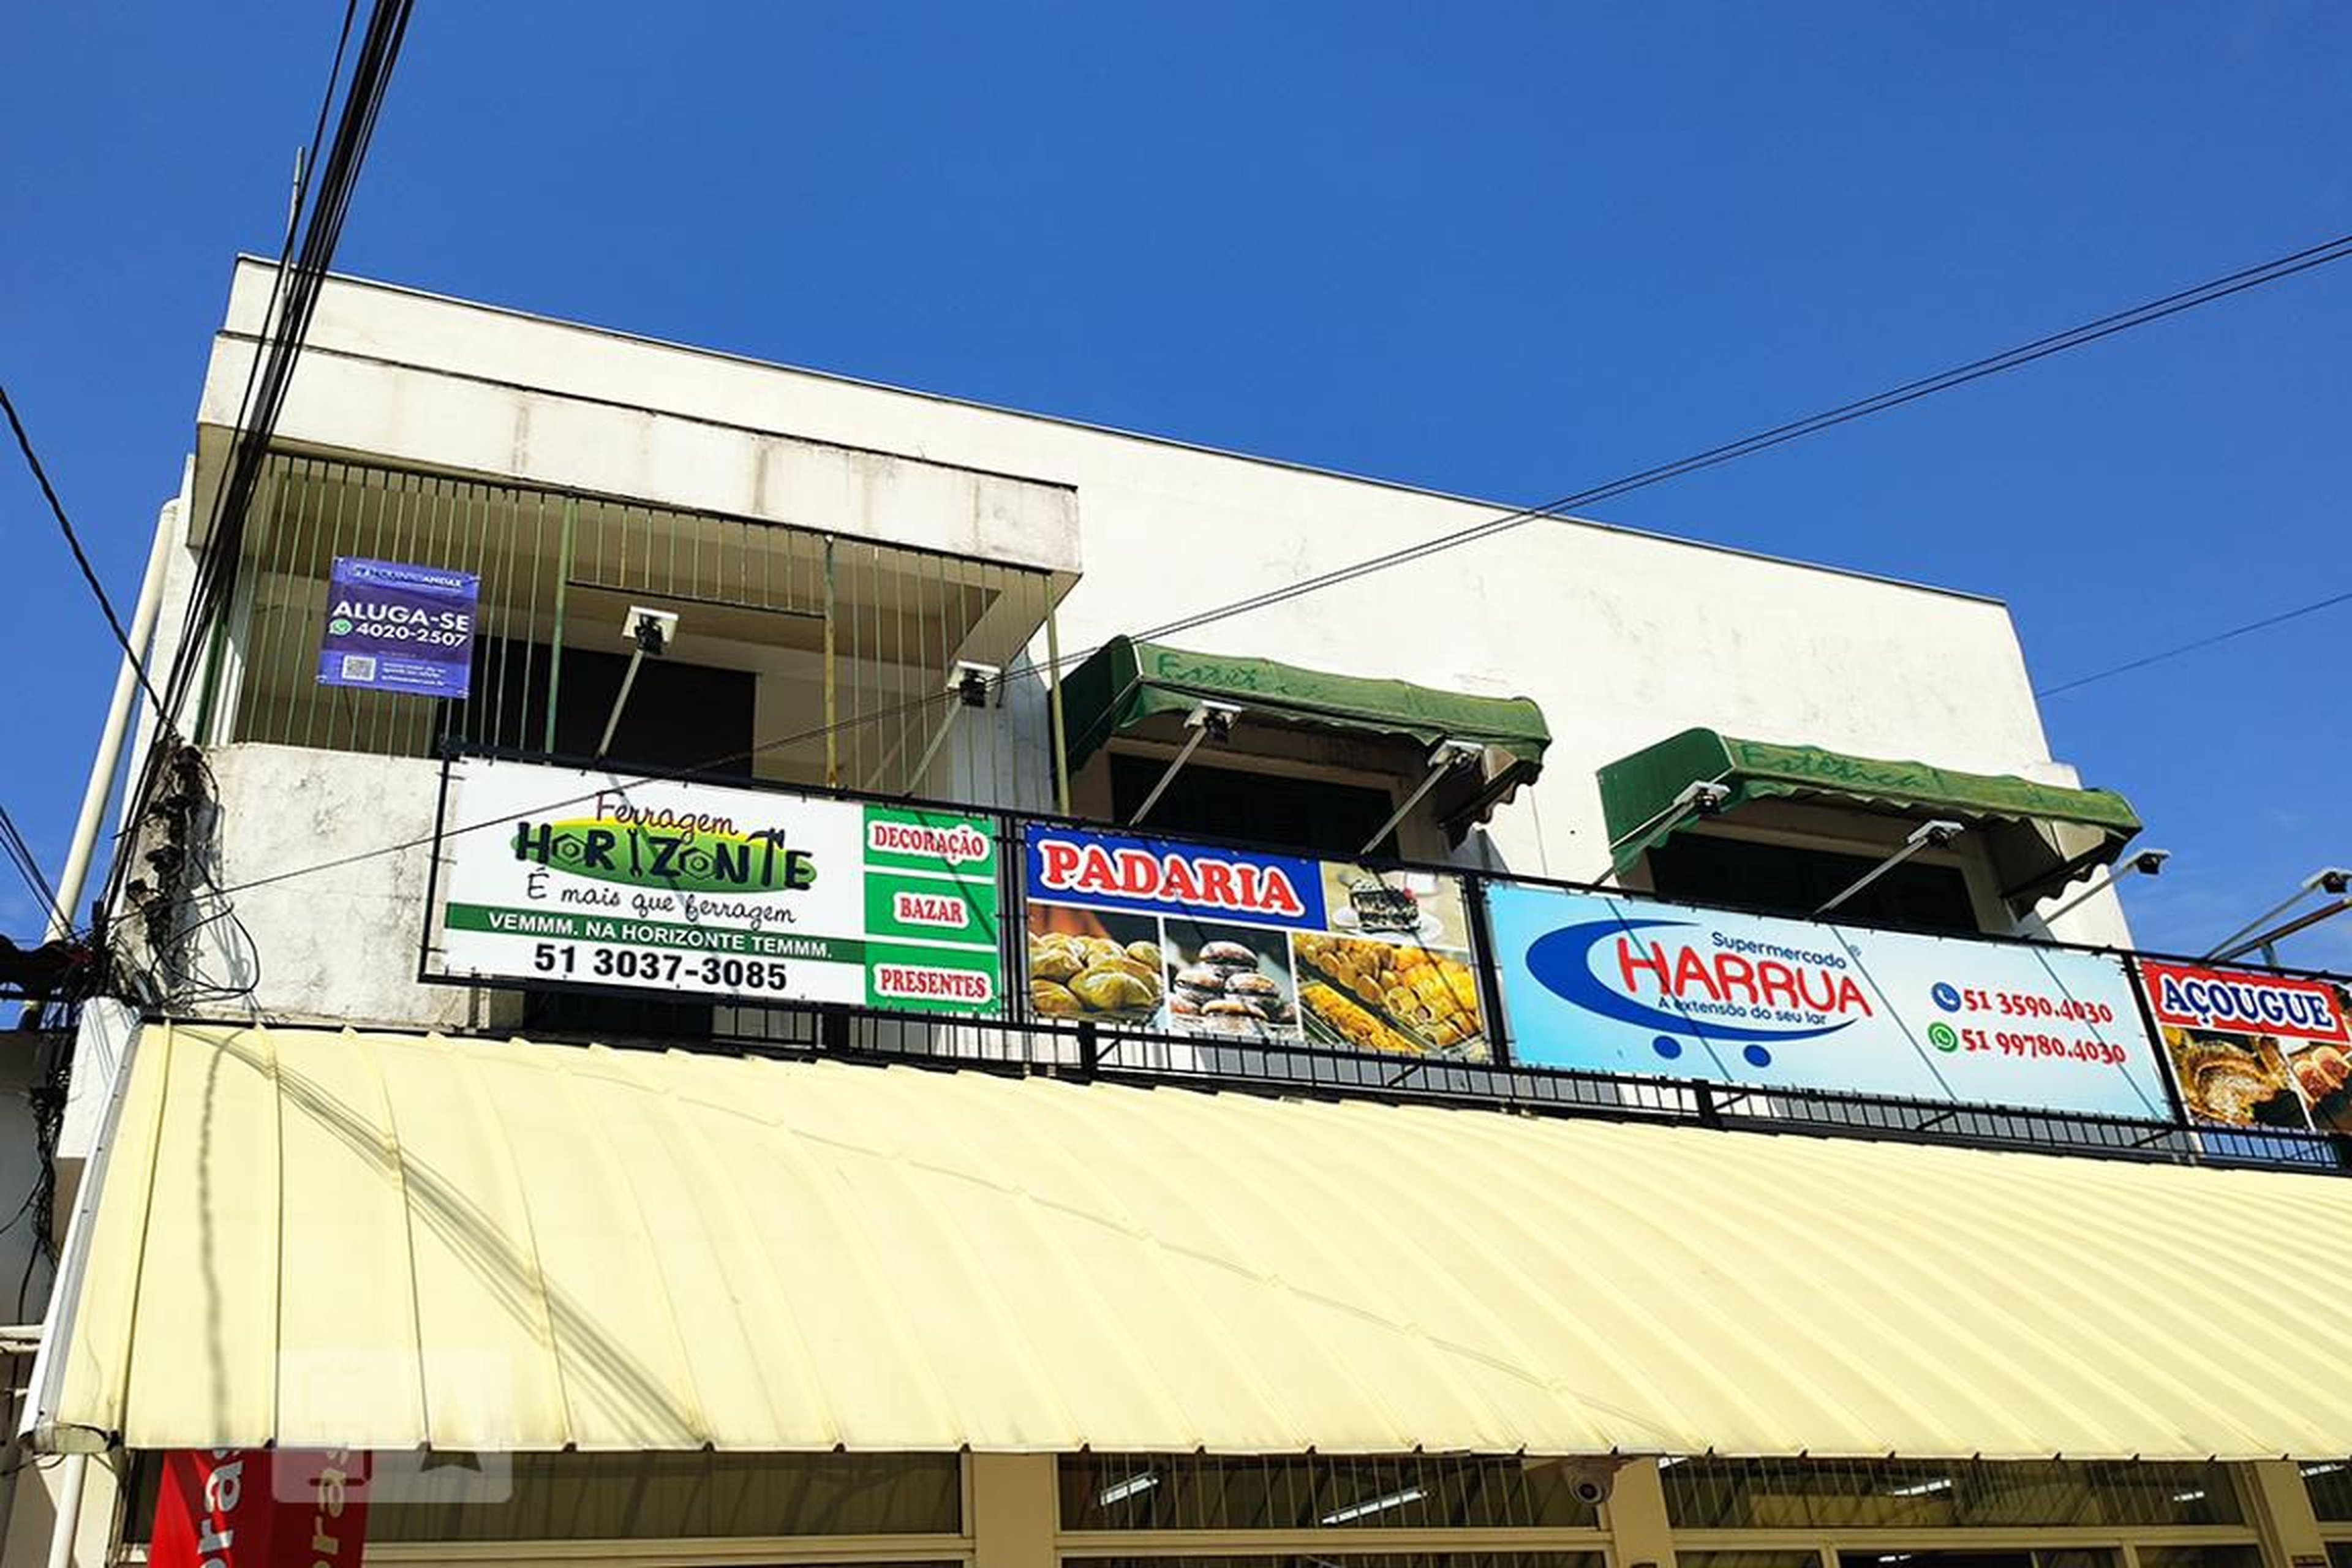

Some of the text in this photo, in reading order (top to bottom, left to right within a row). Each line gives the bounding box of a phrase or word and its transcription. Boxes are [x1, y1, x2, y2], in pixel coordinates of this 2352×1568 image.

[333, 601, 470, 633] ALUGA-SE
[356, 622, 467, 647] 4020-2507
[595, 791, 739, 845] Ferragem
[514, 821, 813, 890] HORIZONTE
[873, 825, 985, 860] DECORAÇÃO
[527, 866, 797, 931] É mais que ferragem
[1041, 843, 1303, 914] PADARIA
[899, 897, 963, 924] BAZAR
[489, 911, 832, 959] VEMMM. NA HORIZONTE TEMMM.
[1711, 930, 1847, 970] Supermercado
[533, 943, 788, 991] 51 3037-3085
[880, 968, 987, 998] PRESENTES
[1616, 937, 1874, 1017] HARRUA
[1658, 995, 1671, 1009] A
[1673, 998, 1746, 1017] extensão
[1750, 1006, 1772, 1020] do
[1776, 1011, 1802, 1023] seu
[1963, 989, 2113, 1024] 51 3590.4030
[2164, 978, 2334, 1029] AÇOUGUE
[1961, 1028, 2126, 1065] 51 99780.4030
